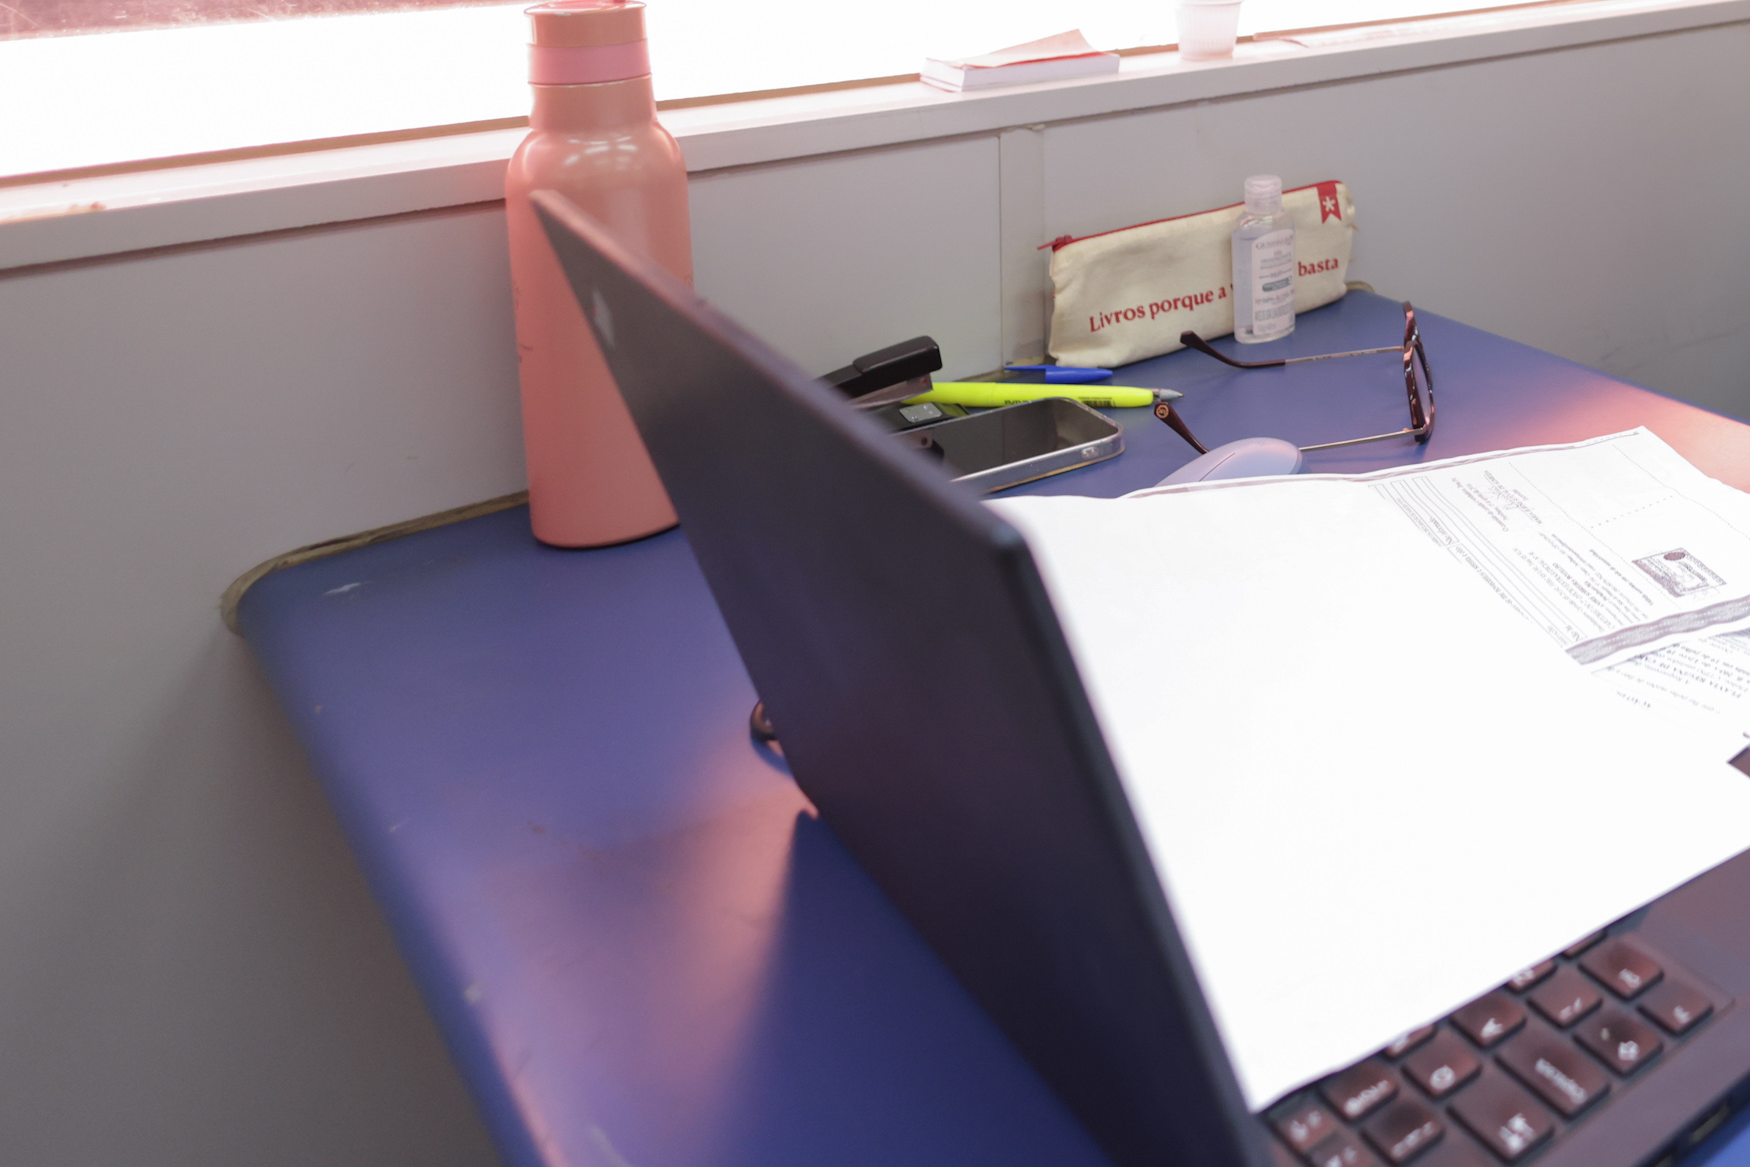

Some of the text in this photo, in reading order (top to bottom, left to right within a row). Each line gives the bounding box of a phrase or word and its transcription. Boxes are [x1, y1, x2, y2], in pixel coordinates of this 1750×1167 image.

[1089, 305, 1145, 332] Livros
[1149, 285, 1213, 320] porque
[1218, 286, 1226, 299] a
[1298, 257, 1339, 277] basta
